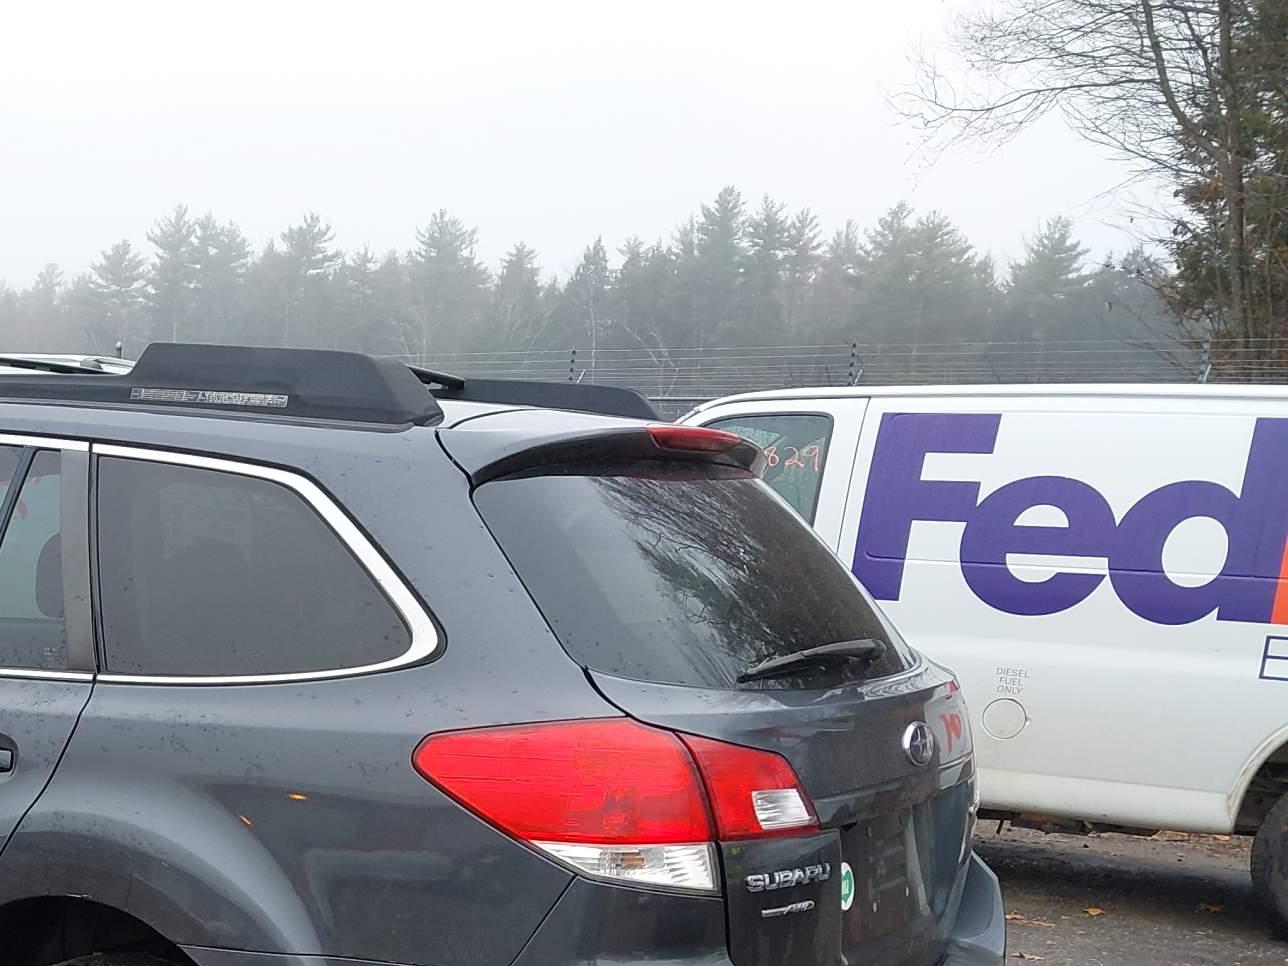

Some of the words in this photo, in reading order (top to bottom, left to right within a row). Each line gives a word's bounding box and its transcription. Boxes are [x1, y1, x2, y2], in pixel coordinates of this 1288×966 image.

[851, 412, 1288, 626] Fed
[996, 667, 1030, 679] DIESEL
[999, 676, 1022, 686] FUEL
[997, 685, 1023, 695] ONLY
[745, 862, 832, 893] SUBARU
